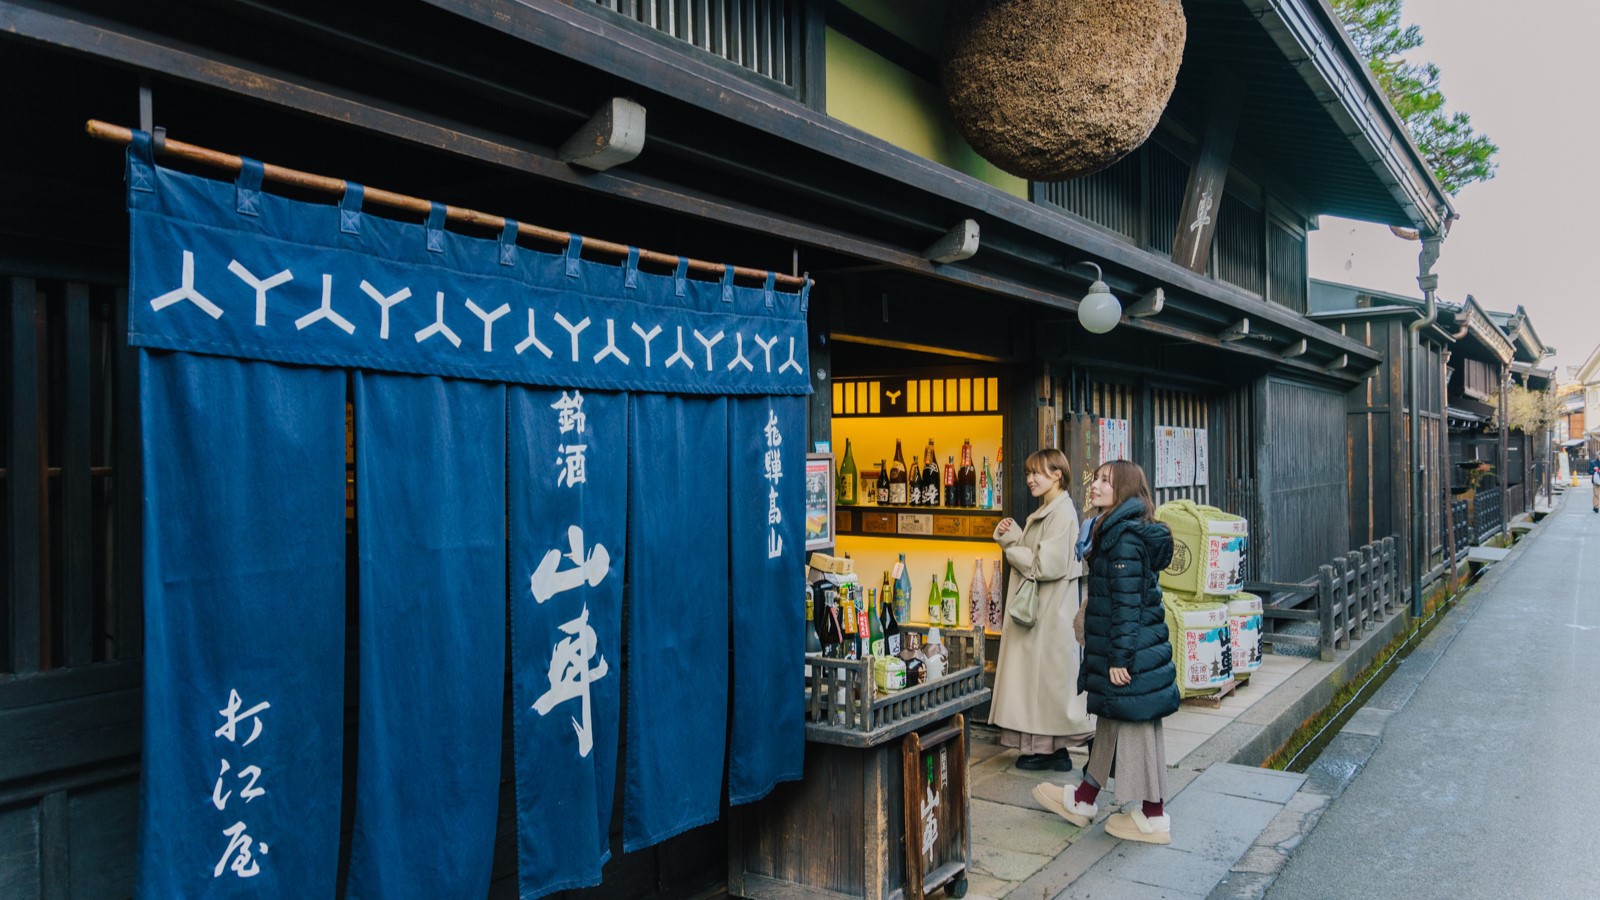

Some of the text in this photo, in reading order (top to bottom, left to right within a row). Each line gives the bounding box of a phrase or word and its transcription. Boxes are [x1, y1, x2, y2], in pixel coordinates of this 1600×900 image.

[550, 389, 588, 489] 銘酒
[530, 524, 611, 758] 山車
[212, 688, 271, 879] 打江屋
